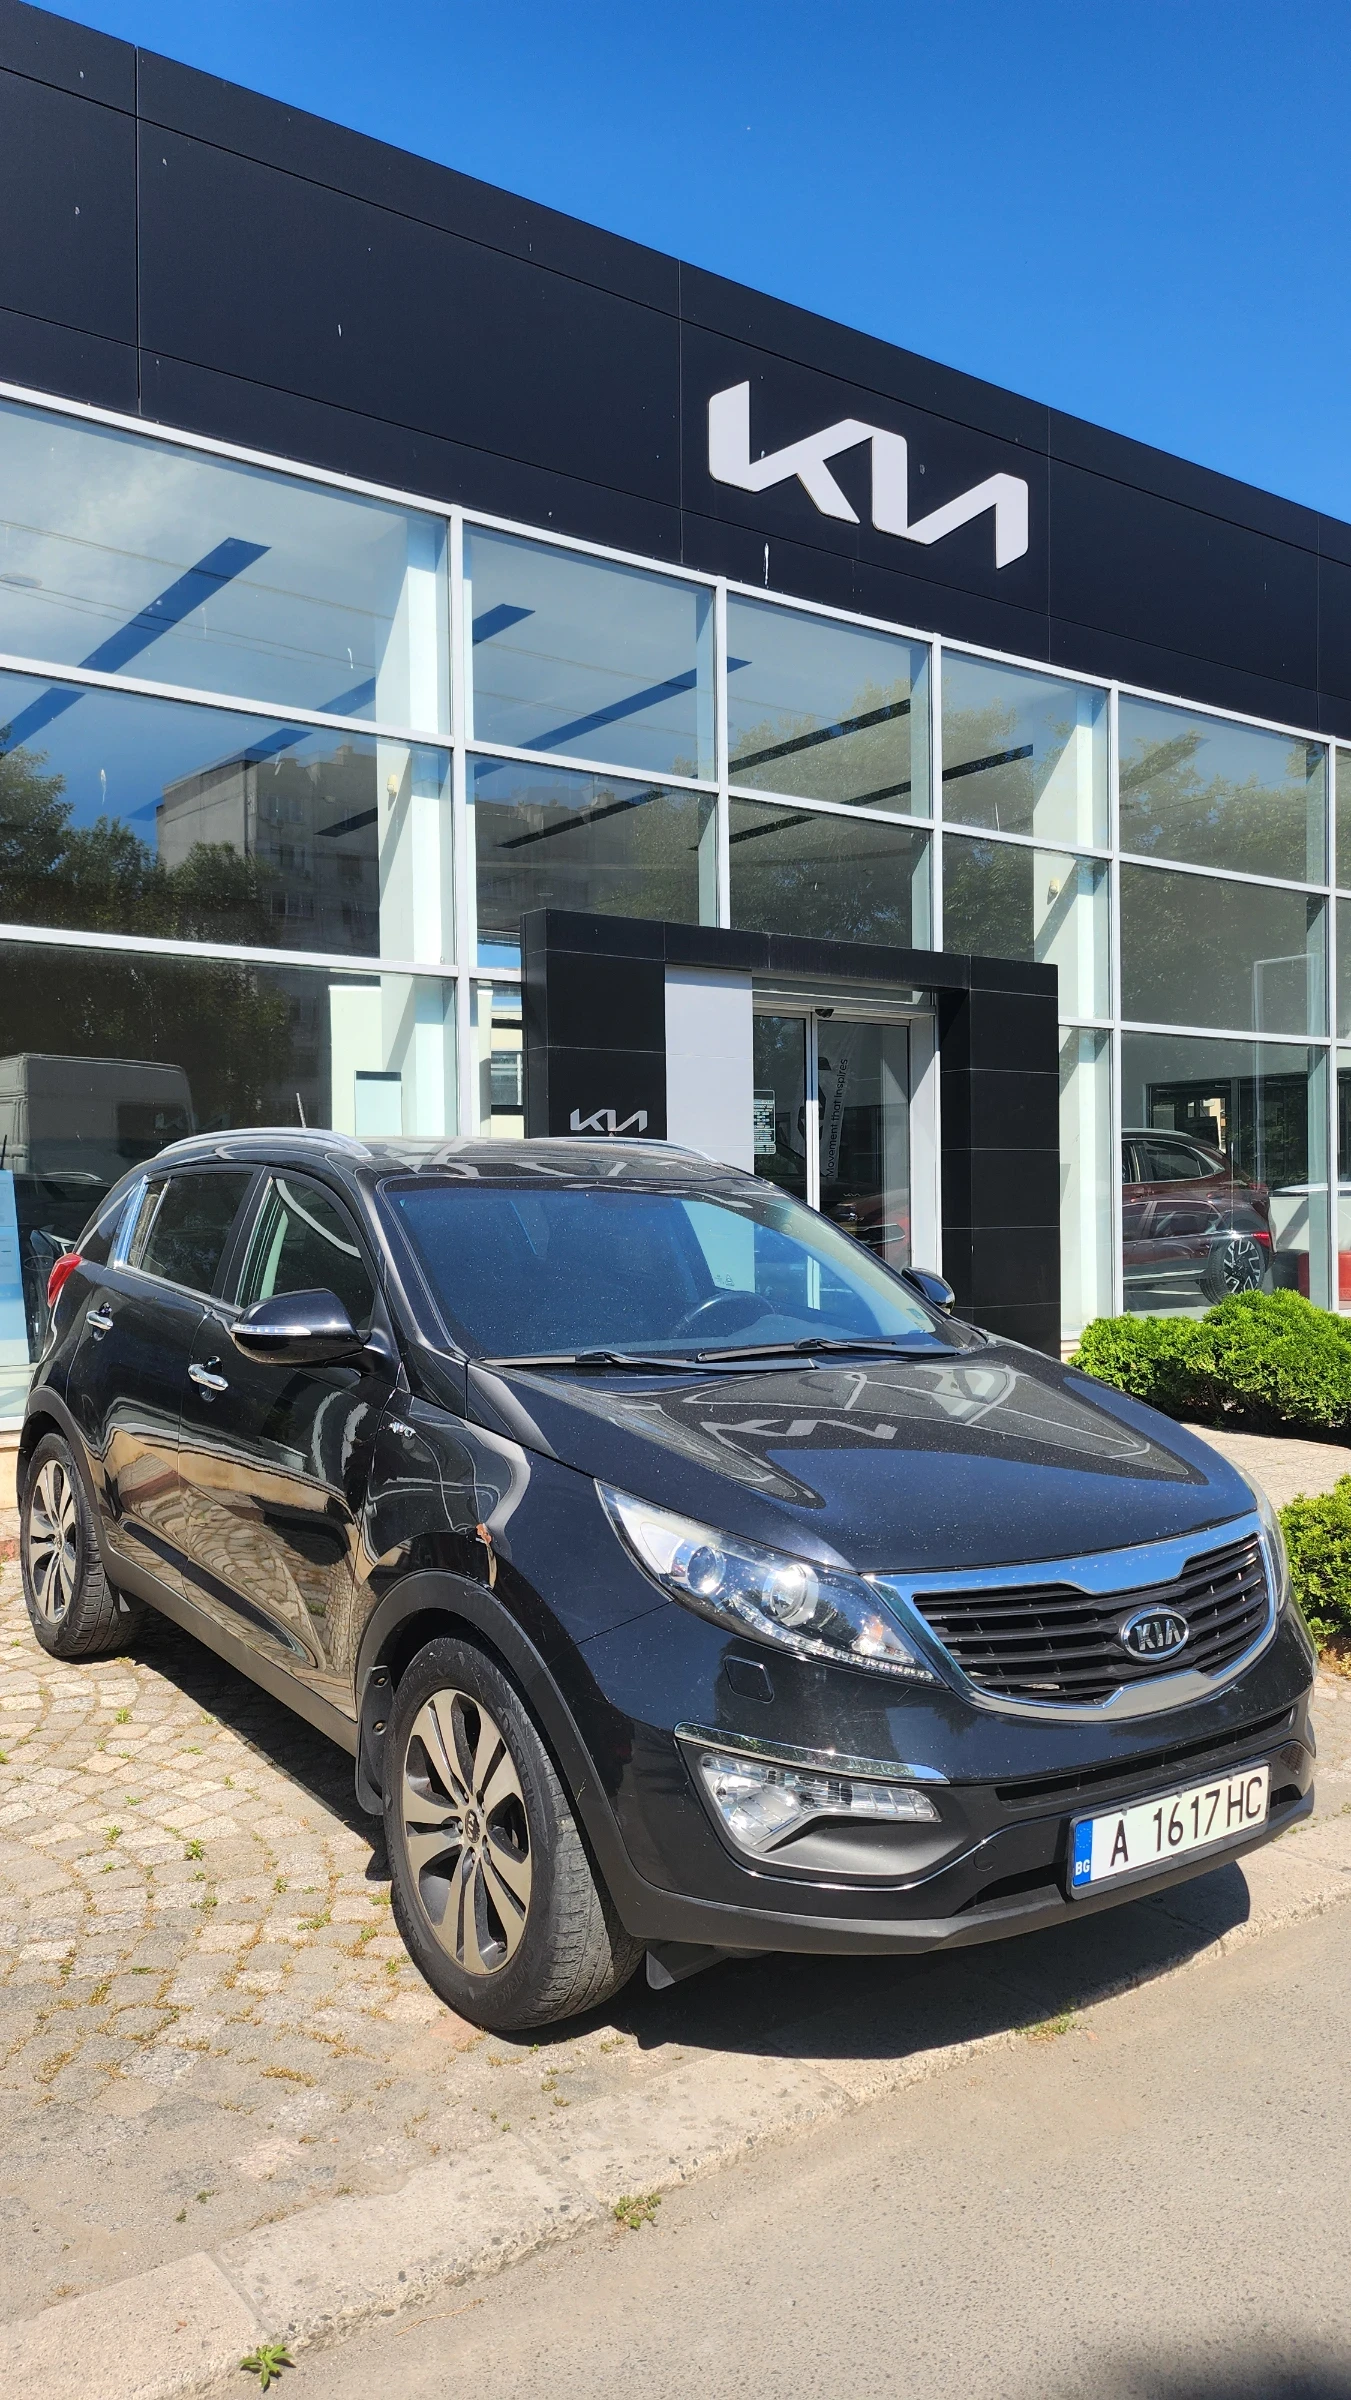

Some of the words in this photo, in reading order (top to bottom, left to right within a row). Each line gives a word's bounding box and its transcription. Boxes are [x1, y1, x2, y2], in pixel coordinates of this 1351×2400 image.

[709, 380, 1028, 569] KIA
[570, 1108, 647, 1132] KIA
[831, 1100, 841, 1121] that
[827, 1124, 838, 1177] Movement
[1135, 1619, 1181, 1650] KIA
[1110, 1819, 1129, 1867] A
[1075, 1859, 1090, 1875] BG
